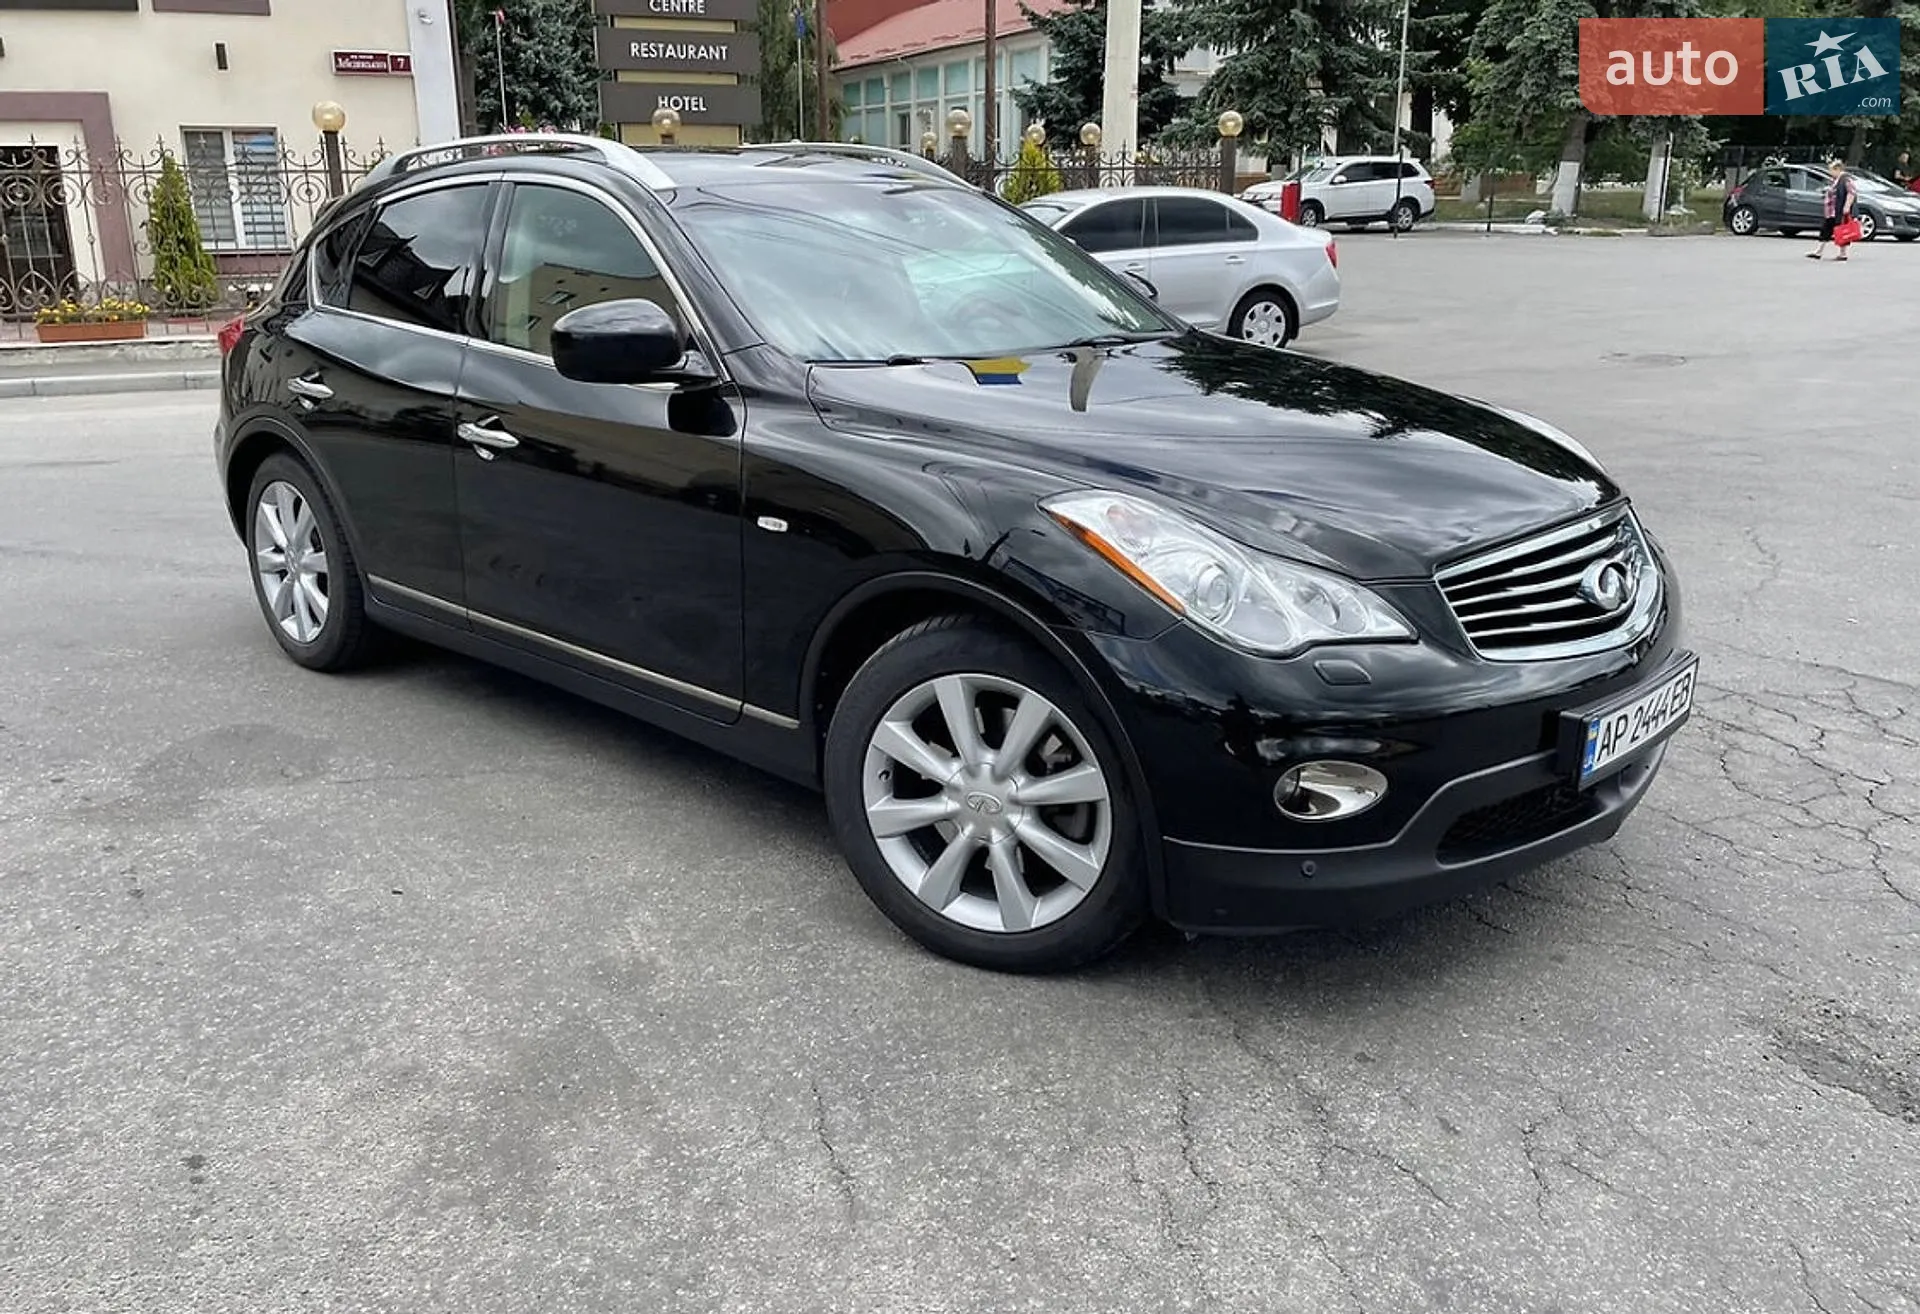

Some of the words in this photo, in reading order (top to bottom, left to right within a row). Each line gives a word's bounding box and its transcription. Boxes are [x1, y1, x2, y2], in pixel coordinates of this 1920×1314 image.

[649, 0, 706, 14] CENTRE
[630, 42, 728, 61] RESTAURANT
[397, 58, 405, 69] 7
[658, 96, 707, 112] HOTEL
[1597, 713, 1628, 761] AP
[1630, 687, 1671, 743] 2444
[1670, 672, 1692, 716] EB
